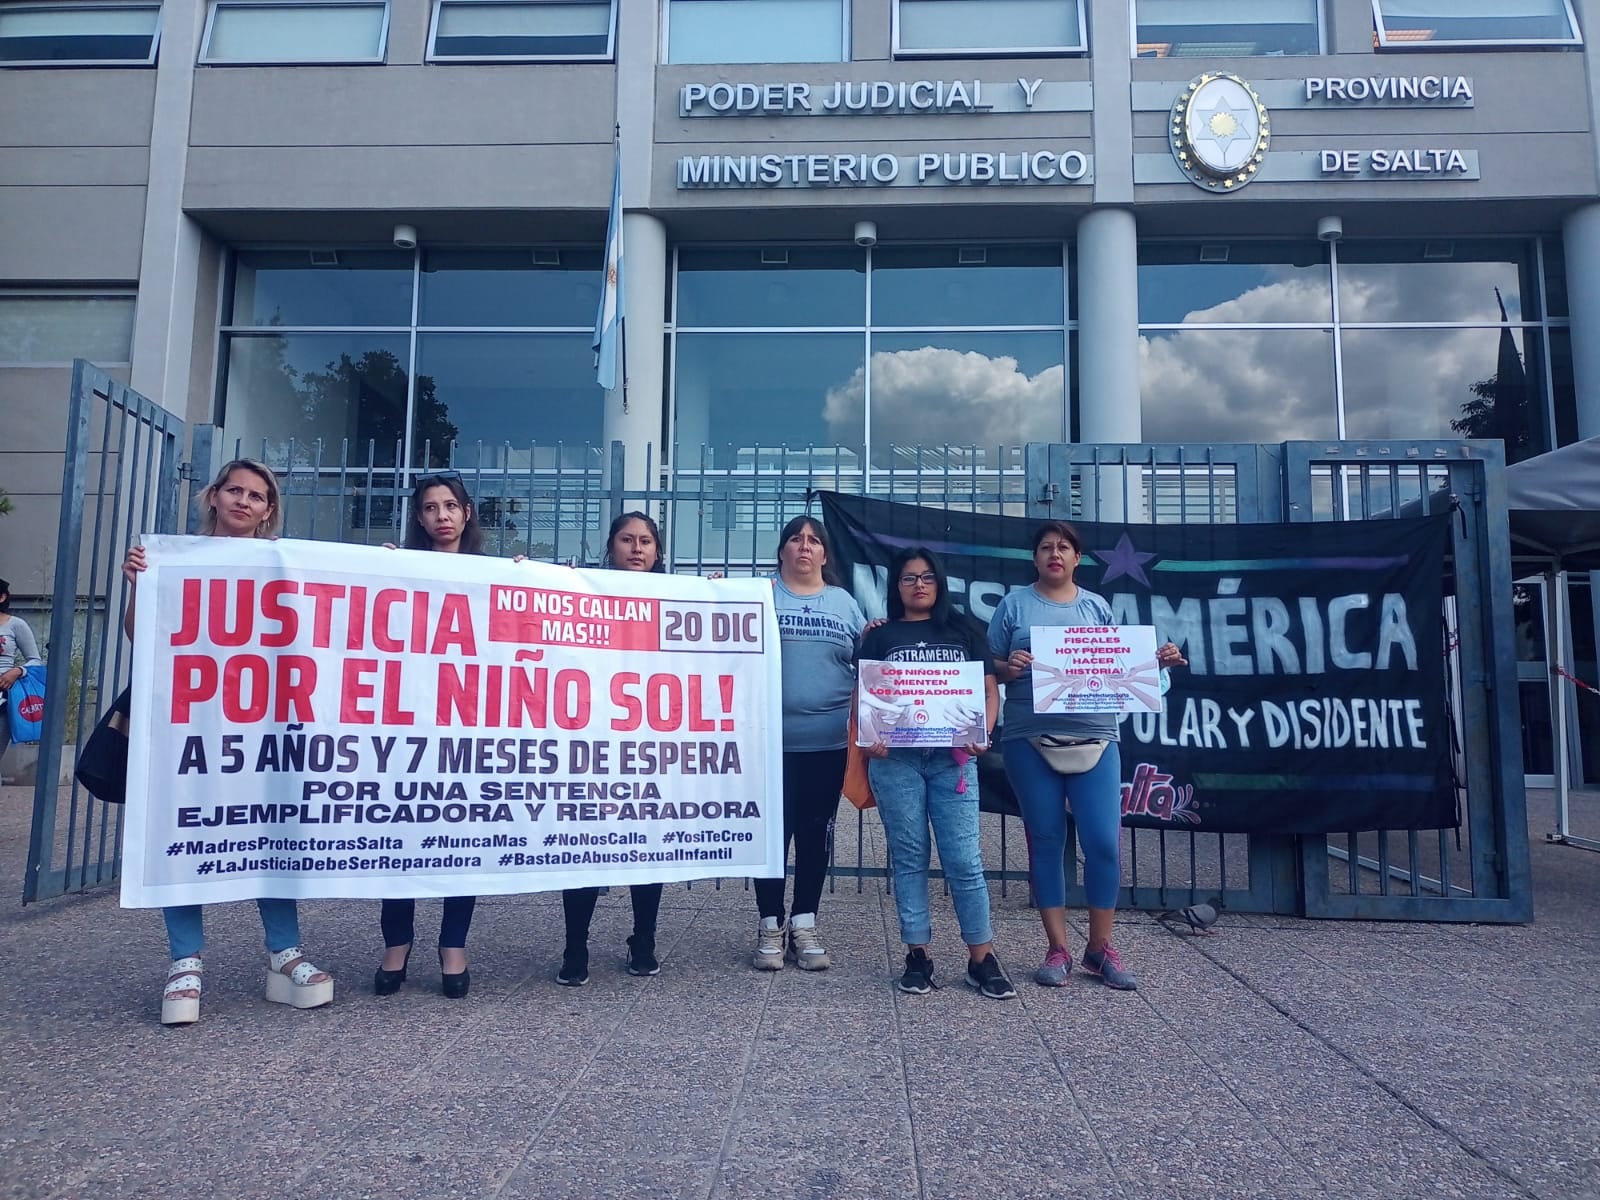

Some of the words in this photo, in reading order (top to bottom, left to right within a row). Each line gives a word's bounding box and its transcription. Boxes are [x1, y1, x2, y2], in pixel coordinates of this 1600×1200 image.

[684, 82, 812, 111] PODER
[823, 79, 993, 111] JUDICIAL
[1017, 77, 1044, 107] Y
[1305, 75, 1473, 100] PROVINCIA
[681, 152, 898, 184] MINISTERIO
[918, 150, 1088, 182] PUBLICO
[1320, 150, 1360, 173] DE
[1371, 149, 1468, 172] SALTA
[170, 578, 477, 656] JUSTICIA
[496, 589, 527, 612] NO
[533, 591, 574, 617] NOS
[579, 597, 652, 622] CALLAN
[541, 619, 610, 646] MAS!!!
[664, 611, 703, 642] 20
[711, 612, 758, 642] DIC
[776, 614, 845, 632] ESTRAMÉRICA
[881, 668, 903, 676] LOS
[171, 654, 317, 724] POR
[339, 658, 415, 726] EL
[435, 649, 591, 730] NIÑO
[609, 671, 735, 732] SOL!
[1227, 706, 1255, 749] Y
[1261, 697, 1427, 749] DISIDENTE
[177, 736, 208, 775] A
[220, 735, 244, 774] 5
[255, 723, 359, 773] AÑOS
[371, 736, 397, 773] Y
[405, 737, 428, 774] 7
[438, 737, 558, 775] MESES
[568, 740, 610, 774] DE
[619, 741, 742, 775] ESPERA
[302, 781, 381, 801] POR
[394, 781, 468, 801] UNA
[479, 781, 661, 801] SENTENCIA
[177, 803, 514, 828] EJEMPLIFICADORA
[524, 803, 546, 822] Y
[556, 800, 761, 822] REPARADORA
[166, 836, 403, 856] #MadresProtectorasSalta
[420, 834, 528, 850] #NuncaMas
[542, 832, 647, 847] #NoNosCalla
[662, 830, 753, 844] #YosiTeCreo
[197, 854, 481, 875] #LaJusticiaDebeSerReparadora
[498, 847, 733, 867] #BastaDeAbusoSexualInfantil
